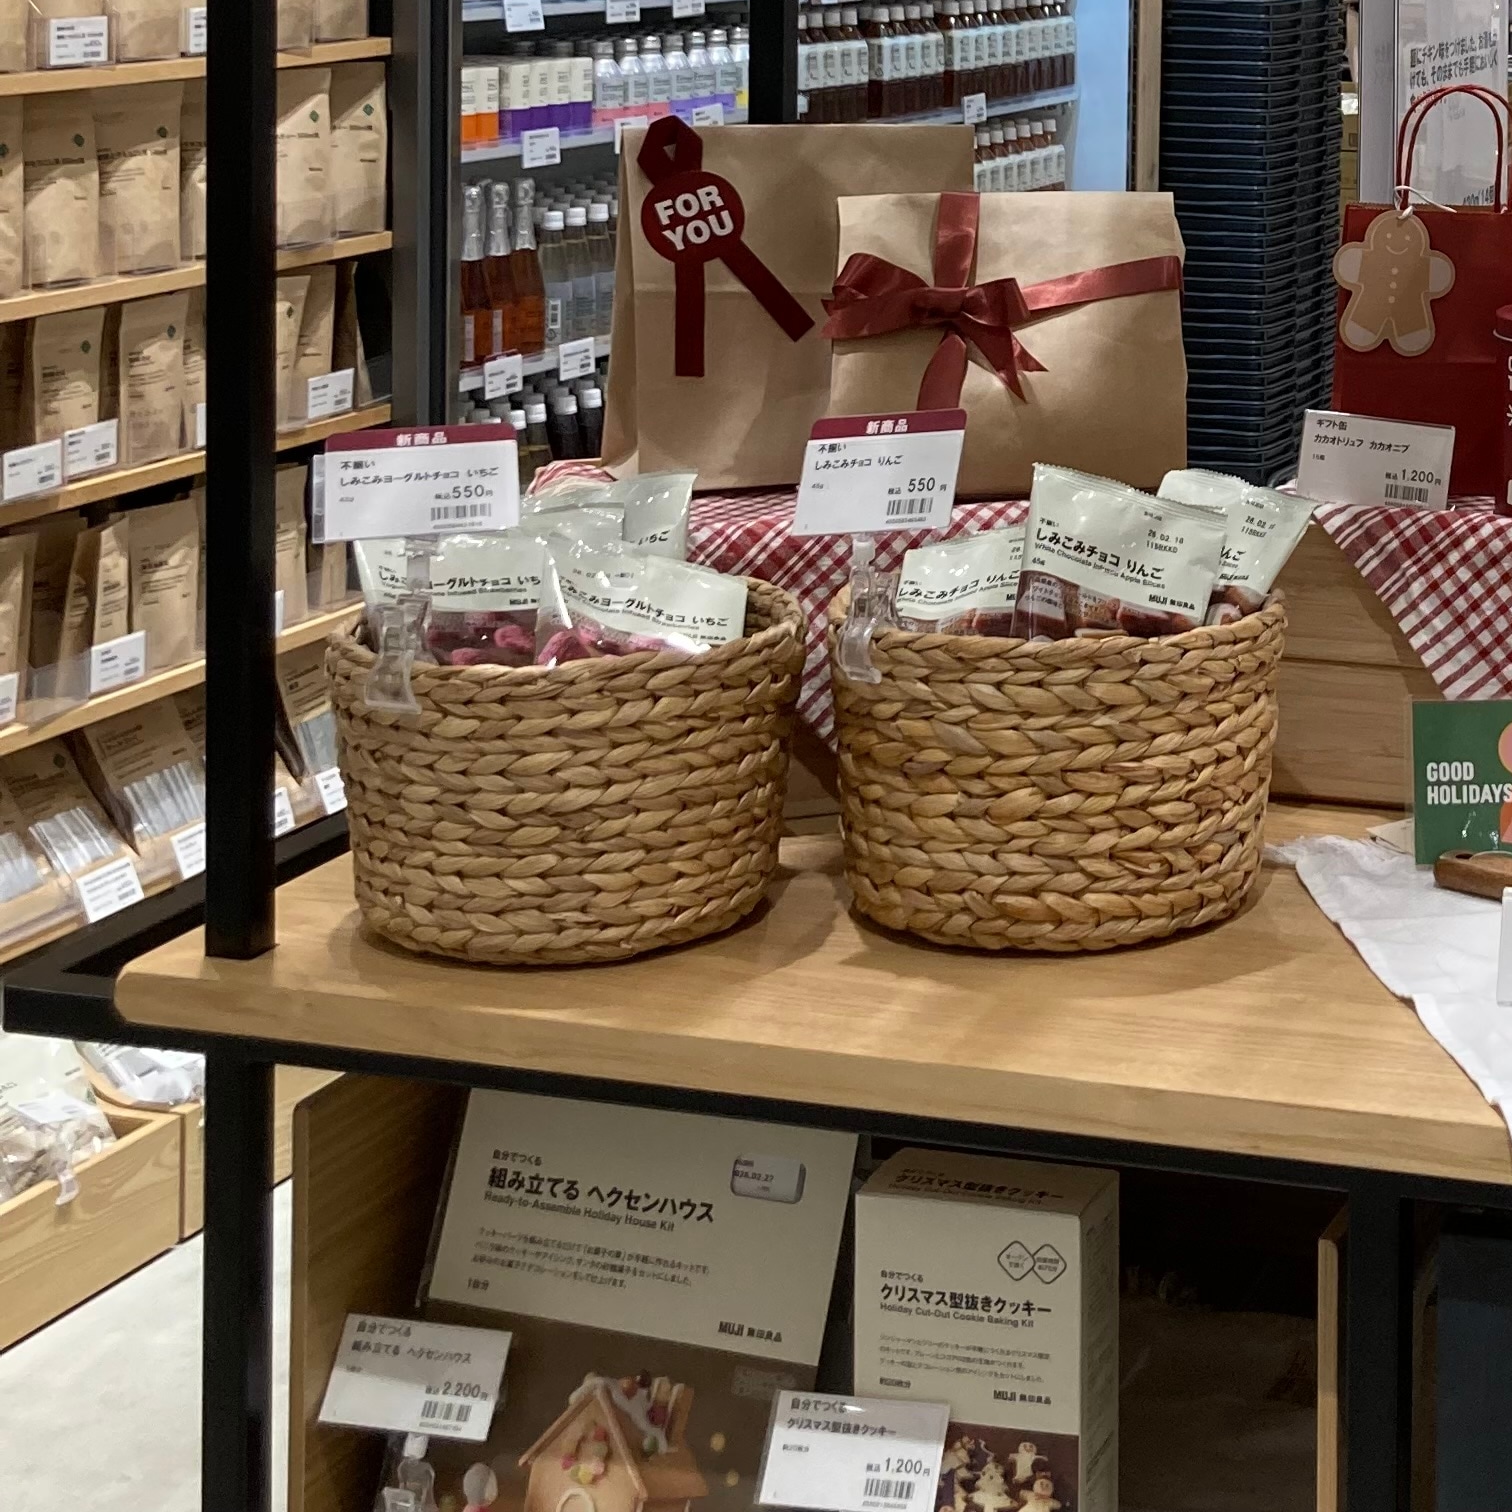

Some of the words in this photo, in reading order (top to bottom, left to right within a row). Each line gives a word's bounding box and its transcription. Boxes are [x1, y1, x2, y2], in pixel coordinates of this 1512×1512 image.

[654, 185, 724, 226] FOR
[661, 209, 734, 251] YOU
[866, 419, 908, 435] 新商品
[1316, 418, 1348, 431] ギフト缶
[396, 431, 447, 447] 新商品
[1314, 434, 1364, 447] カカオトリュフ
[1369, 441, 1410, 453] カカオニブ
[815, 458, 872, 471] しみこみチョコ
[877, 455, 903, 466] りんご
[340, 471, 459, 487] しみこみヨーグルトチョコ
[467, 466, 499, 478] いちご
[907, 477, 936, 493] 550
[1036, 527, 1121, 567] しみこみチョコ
[1126, 558, 1164, 580] りんご
[899, 579, 979, 600] しみこみチョコ
[986, 569, 1020, 583] りんご
[1148, 593, 1168, 606] MUJI
[692, 615, 729, 628] いちご
[1426, 761, 1475, 782] GOOD
[493, 1149, 542, 1166] 自分でつくる
[488, 1166, 580, 1201] 組み立てる
[587, 1185, 714, 1223] ヘクセンハウス
[484, 1191, 581, 1217] Ready-to-Assemble
[583, 1208, 623, 1225] Holiday
[624, 1214, 657, 1229] House
[659, 1220, 675, 1232] Kit
[880, 1270, 923, 1283] 自分でつくる
[880, 1283, 1052, 1317] クリスマス型抜きクッキー
[880, 1303, 913, 1316] Holiday
[915, 1307, 950, 1319] Cut-Out
[953, 1312, 985, 1323] Cookie
[987, 1316, 1019, 1329] Baking
[1021, 1319, 1034, 1328] Kit
[356, 1320, 411, 1337] 自分でつくる
[718, 1321, 744, 1337] MUJI
[747, 1326, 783, 1343] 無印良品
[351, 1340, 400, 1356] 組み立てる
[406, 1347, 472, 1364] ヘクセンハウス
[993, 1390, 1016, 1402] MUJI
[787, 1418, 897, 1437] クリスマス型抜きクッキー
